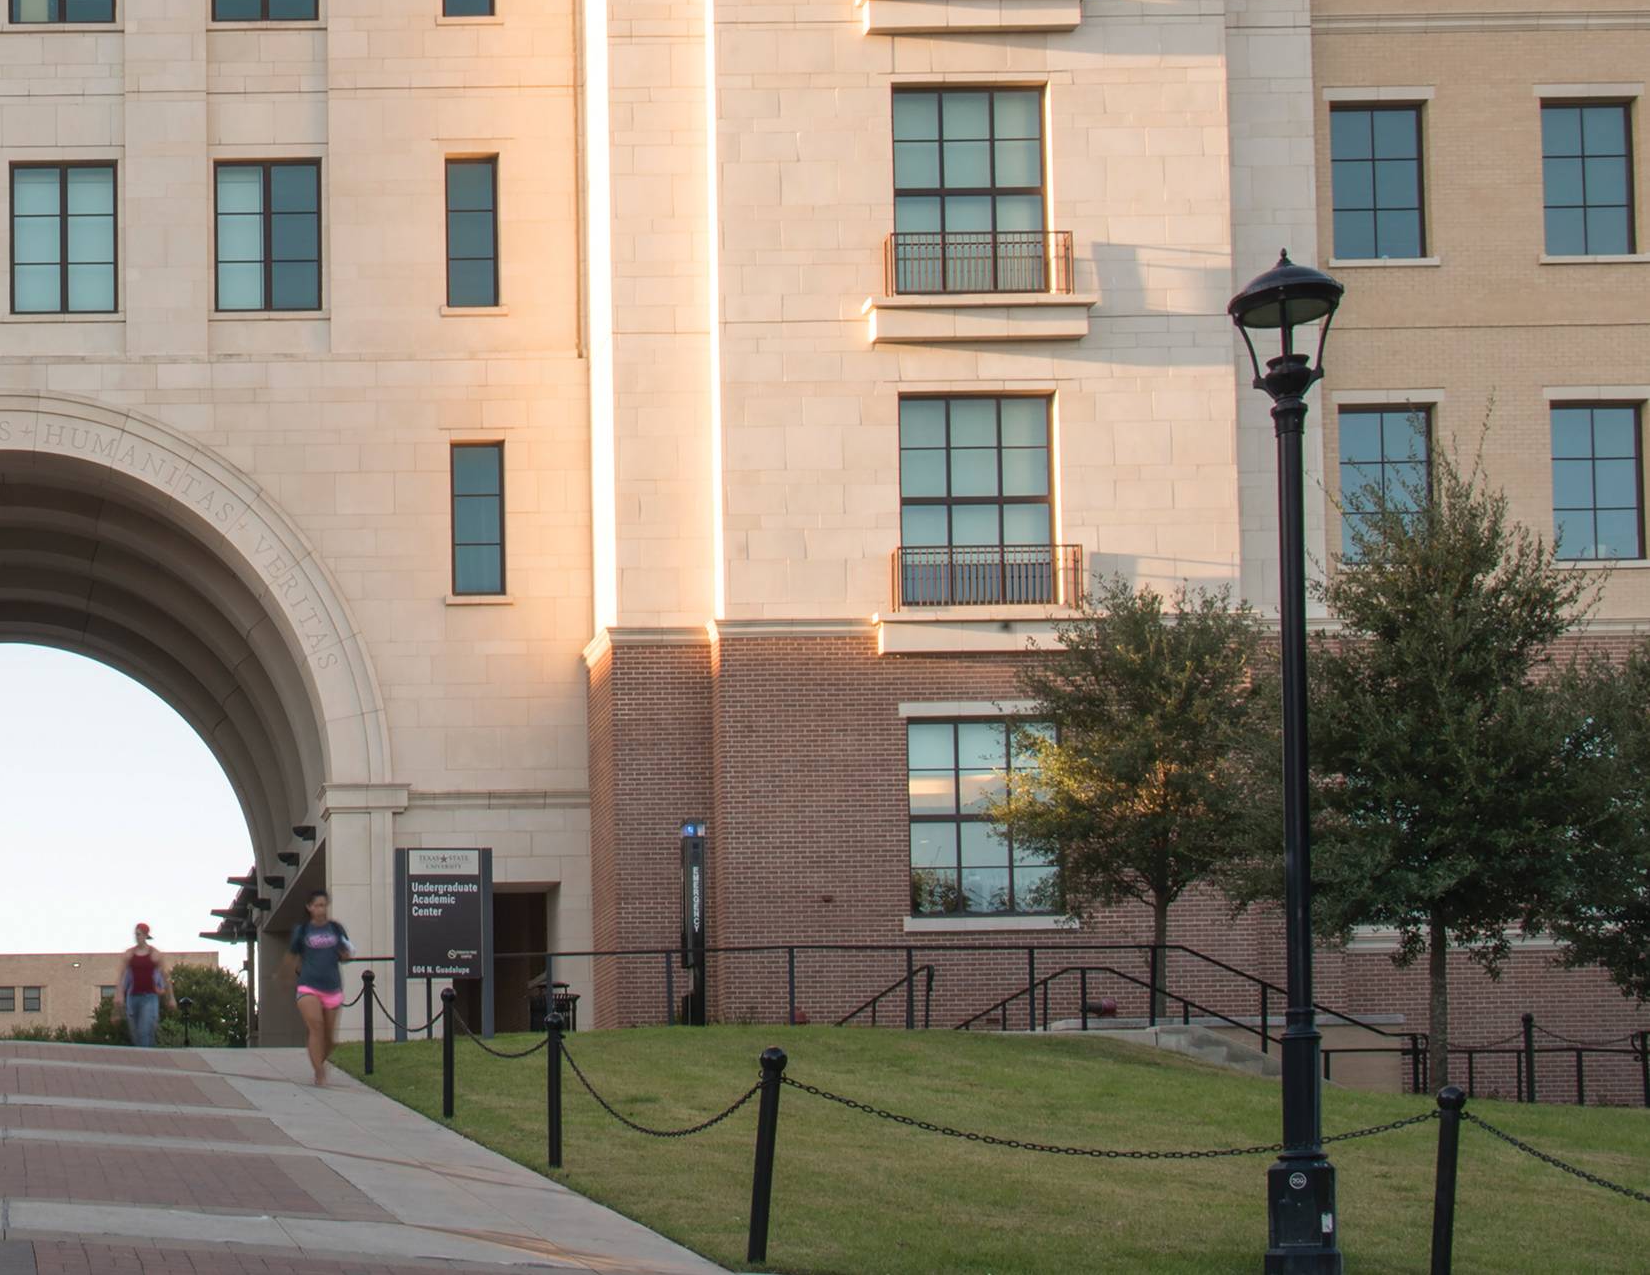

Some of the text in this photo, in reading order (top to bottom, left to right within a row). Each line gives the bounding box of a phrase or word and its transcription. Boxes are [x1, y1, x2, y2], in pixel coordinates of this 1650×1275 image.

[43, 422, 236, 524] HUMANITAS
[251, 532, 338, 671] VERITAS
[411, 882, 478, 894] Undergraduate
[412, 893, 456, 905] Academic
[692, 866, 700, 933] EMERGENCY
[412, 905, 443, 917] Center
[412, 965, 470, 976] 604 N. Guadalupe
